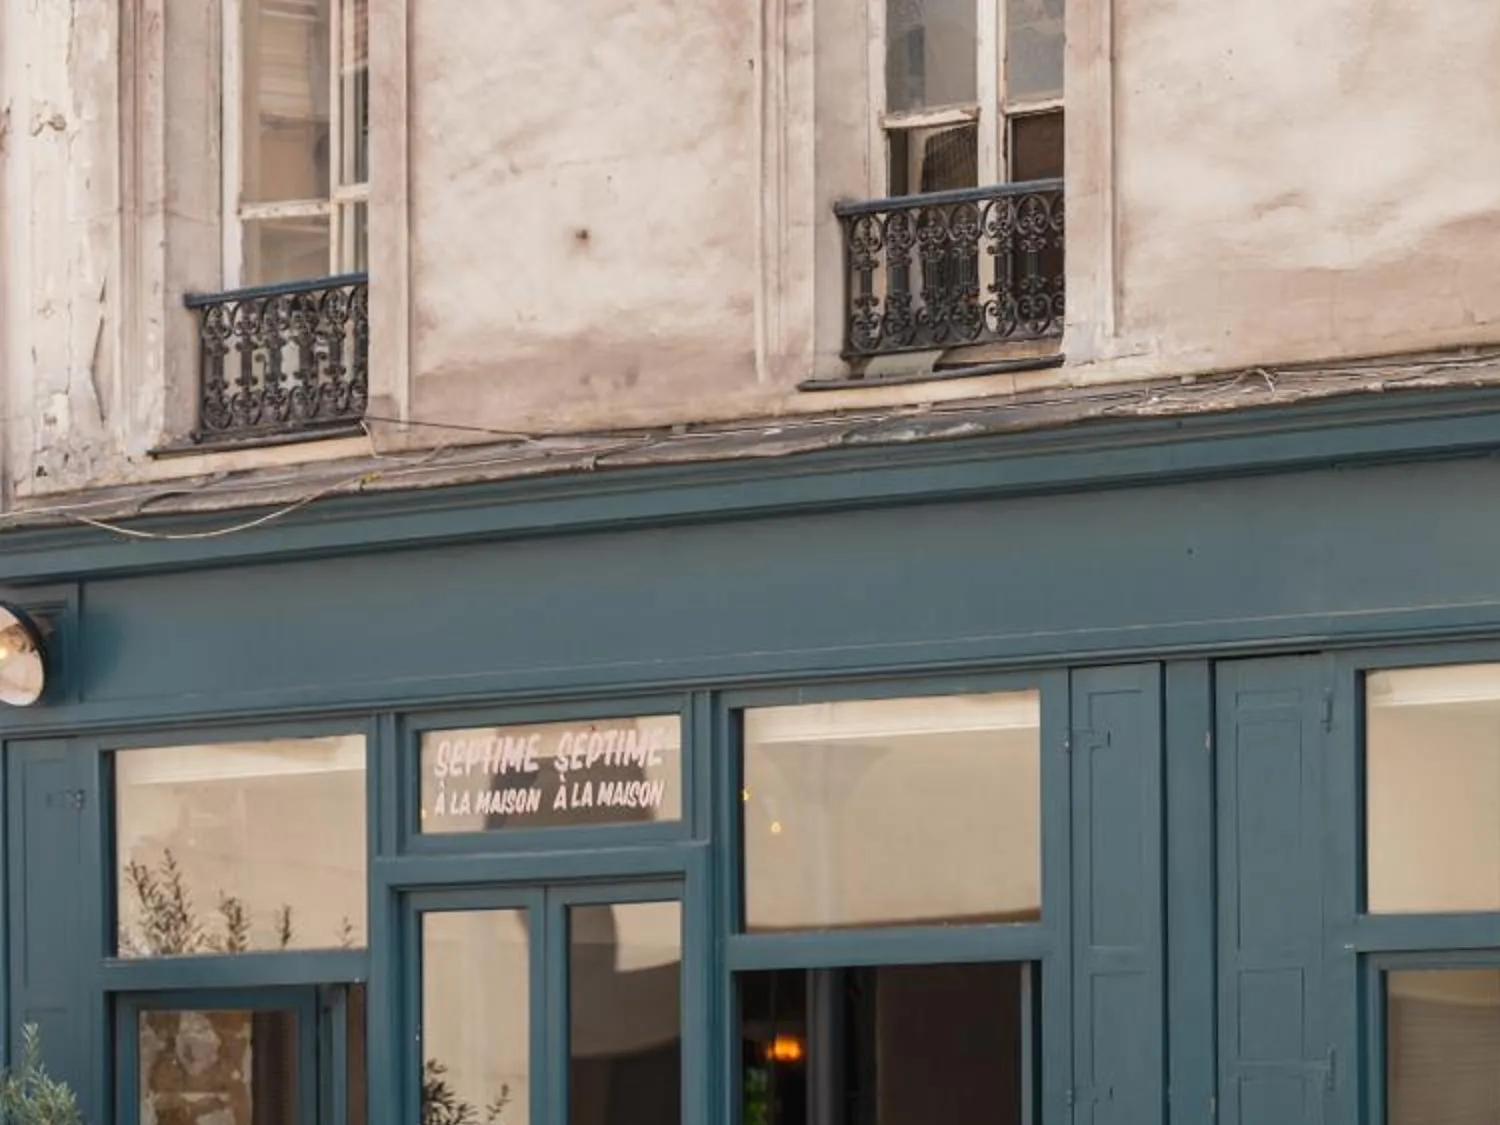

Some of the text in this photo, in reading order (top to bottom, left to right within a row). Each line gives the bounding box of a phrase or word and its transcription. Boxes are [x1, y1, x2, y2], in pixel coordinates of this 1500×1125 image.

[434, 727, 664, 778] SEPTIME SEPTIME
[435, 773, 665, 816] À LA MAISON À LA MAISON
